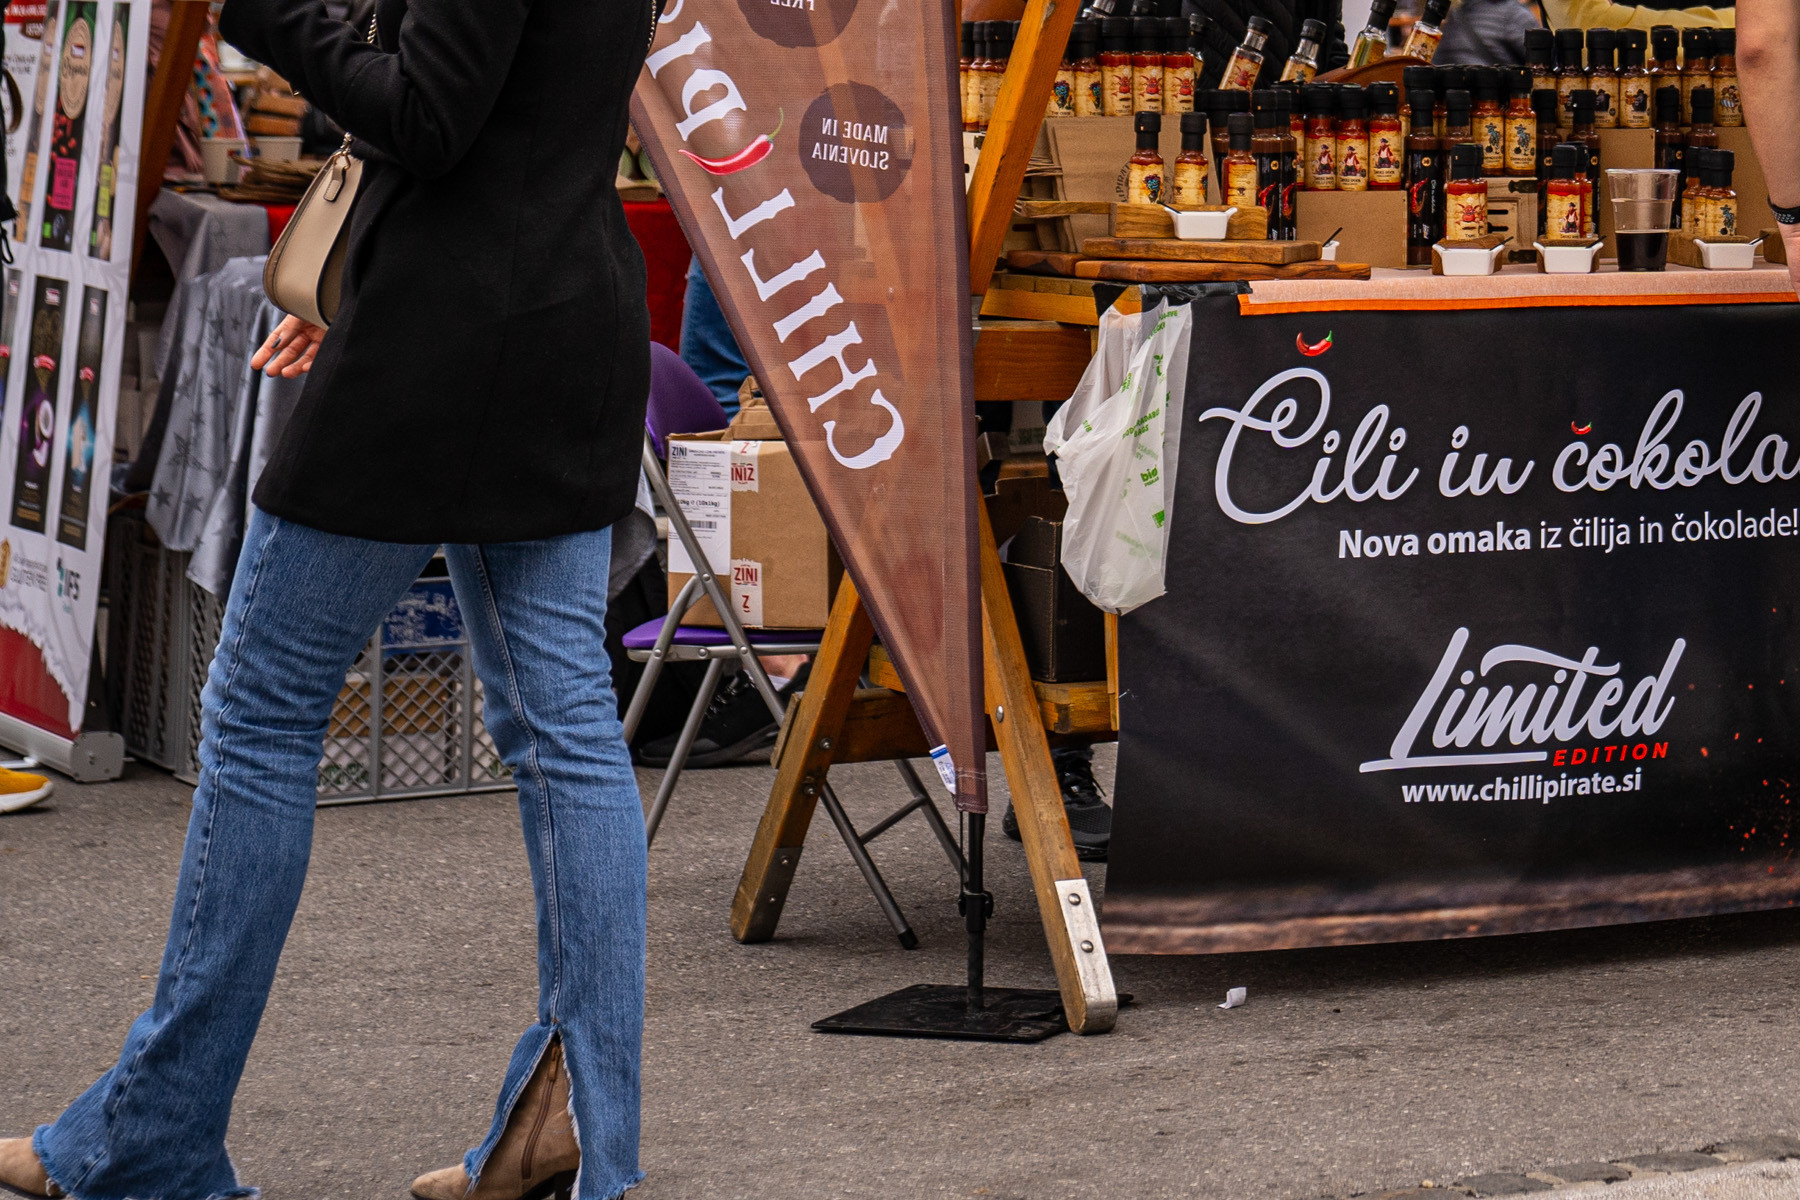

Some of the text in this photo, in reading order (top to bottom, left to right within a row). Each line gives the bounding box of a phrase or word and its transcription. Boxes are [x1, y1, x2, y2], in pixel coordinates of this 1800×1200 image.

[1198, 330, 1420, 524] Čili
[1438, 425, 1535, 498] in
[671, 446, 687, 457] ZINI
[1338, 508, 1800, 559] Nova omaka iz čilija in čokolade!
[734, 567, 758, 581] ZINI
[1380, 627, 1687, 764] Limited
[1553, 742, 1669, 767] EDITION
[1402, 767, 1642, 804] www.chillipirate.si
